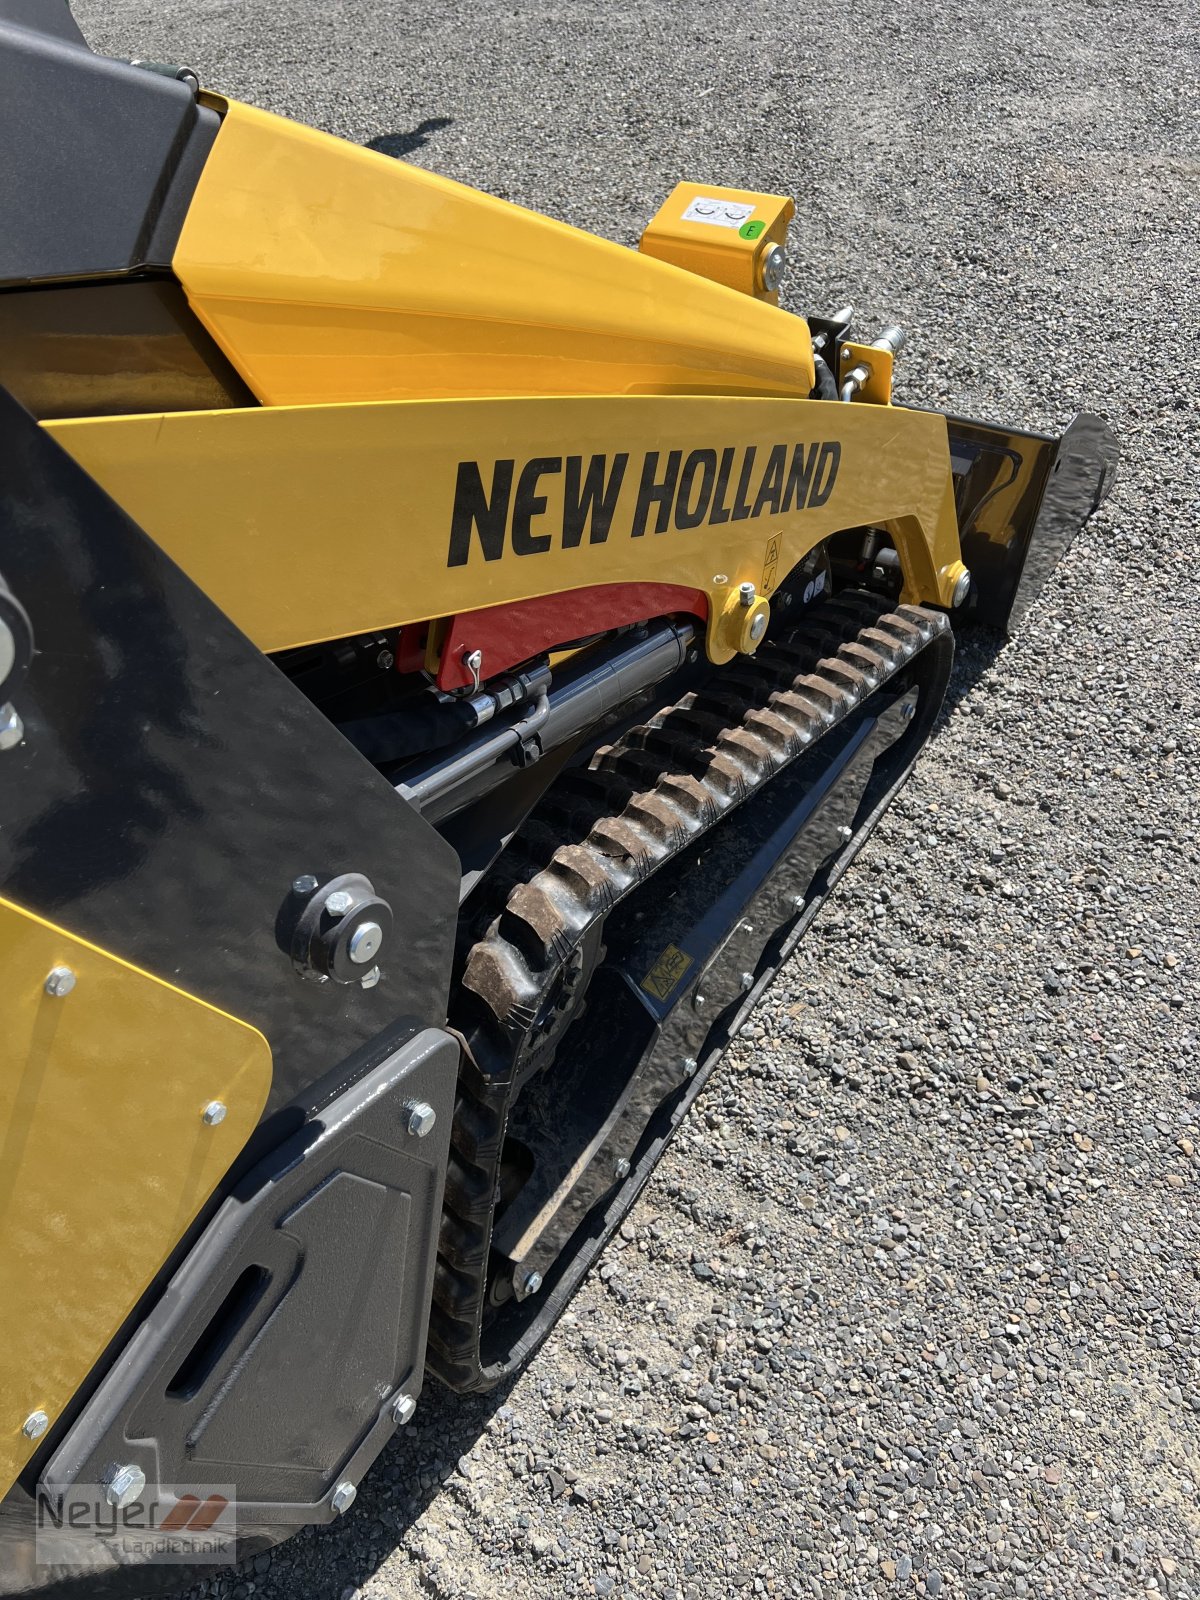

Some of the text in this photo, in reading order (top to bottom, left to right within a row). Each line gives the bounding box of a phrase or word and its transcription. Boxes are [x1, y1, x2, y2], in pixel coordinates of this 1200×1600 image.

[746, 225, 755, 236] E
[447, 441, 841, 567] NEW HOLLAND
